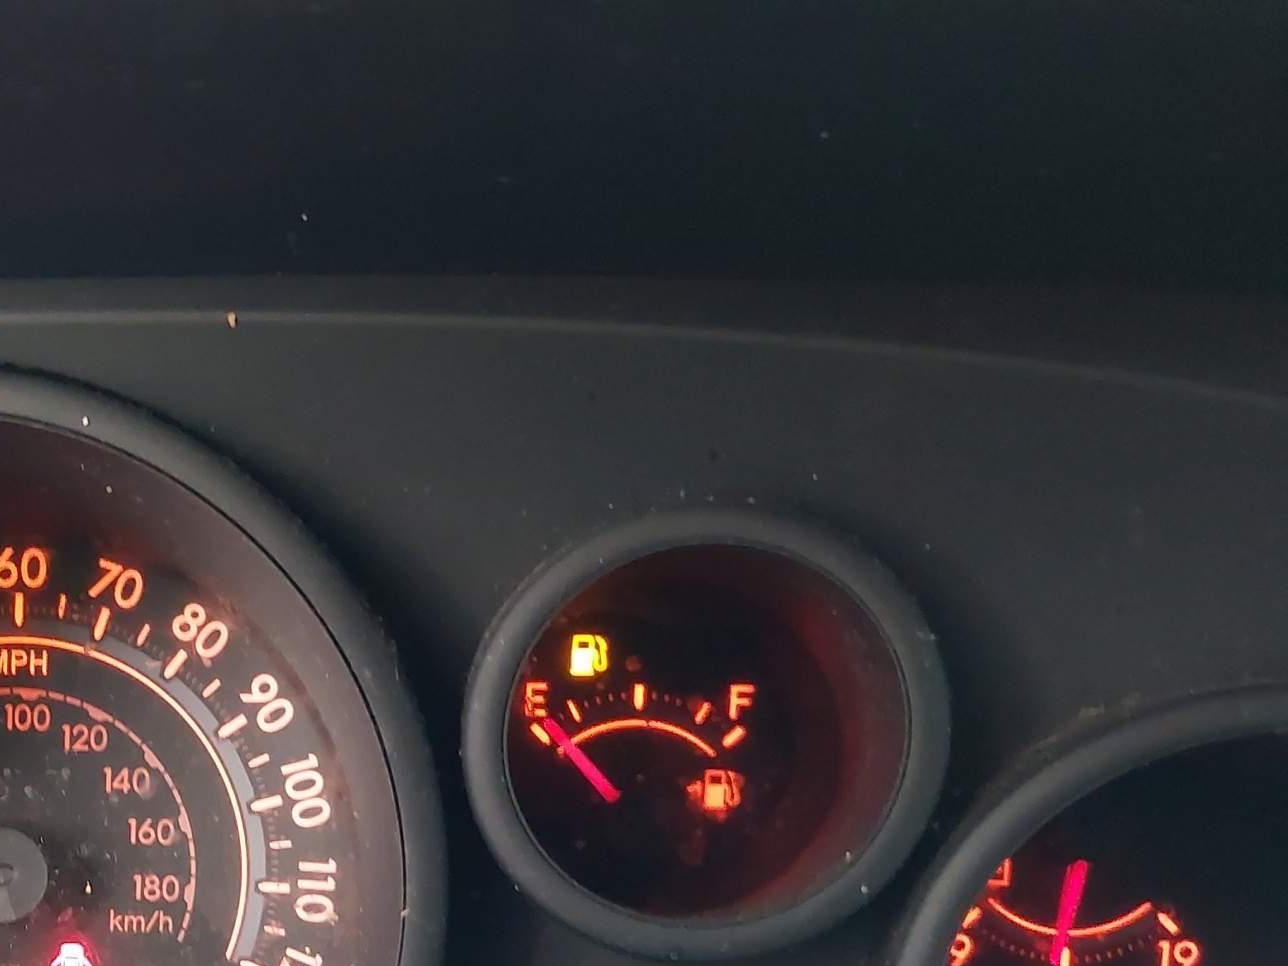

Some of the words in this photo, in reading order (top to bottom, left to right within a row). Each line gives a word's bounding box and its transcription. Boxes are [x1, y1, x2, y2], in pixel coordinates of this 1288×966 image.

[88, 557, 143, 609] 70
[171, 602, 229, 659] 80
[240, 672, 295, 734] 90
[524, 682, 549, 717] E
[729, 684, 756, 720] F
[4, 703, 51, 732] 100
[62, 724, 108, 752] 120
[103, 766, 149, 794] 140
[280, 752, 332, 829] 100
[128, 817, 174, 845] 160
[133, 873, 180, 902] 180
[297, 857, 337, 925] 110
[109, 909, 174, 934] km/h
